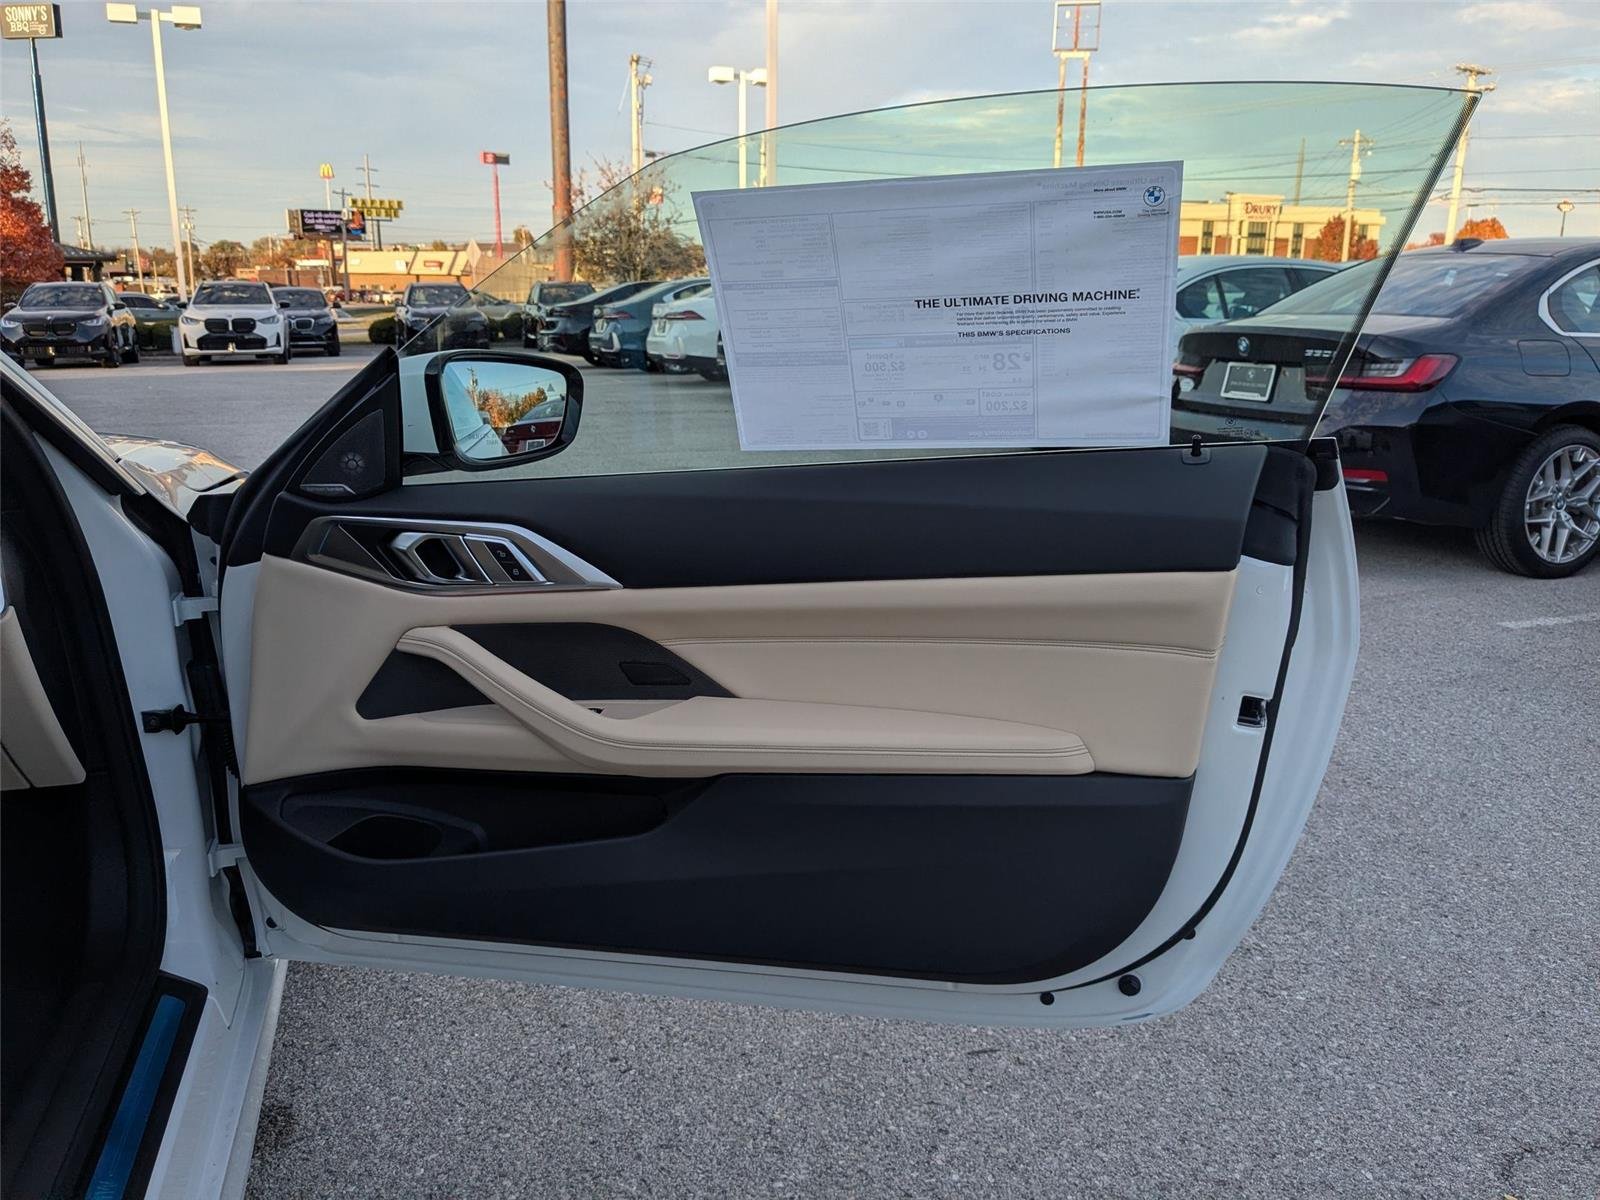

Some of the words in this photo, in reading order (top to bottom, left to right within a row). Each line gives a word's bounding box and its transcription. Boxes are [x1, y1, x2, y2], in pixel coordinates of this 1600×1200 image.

[5, 5, 48, 22] SONNY'S
[10, 21, 30, 33] BBQ
[365, 209, 399, 217] OUSE
[1245, 201, 1278, 215] DRURY
[915, 298, 940, 309] THE
[943, 295, 1009, 307] ULTIMATE
[1013, 292, 1068, 305] DRIVING
[977, 330, 1004, 338] BMW'S
[1005, 327, 1071, 337] SPECIFICATIONS
